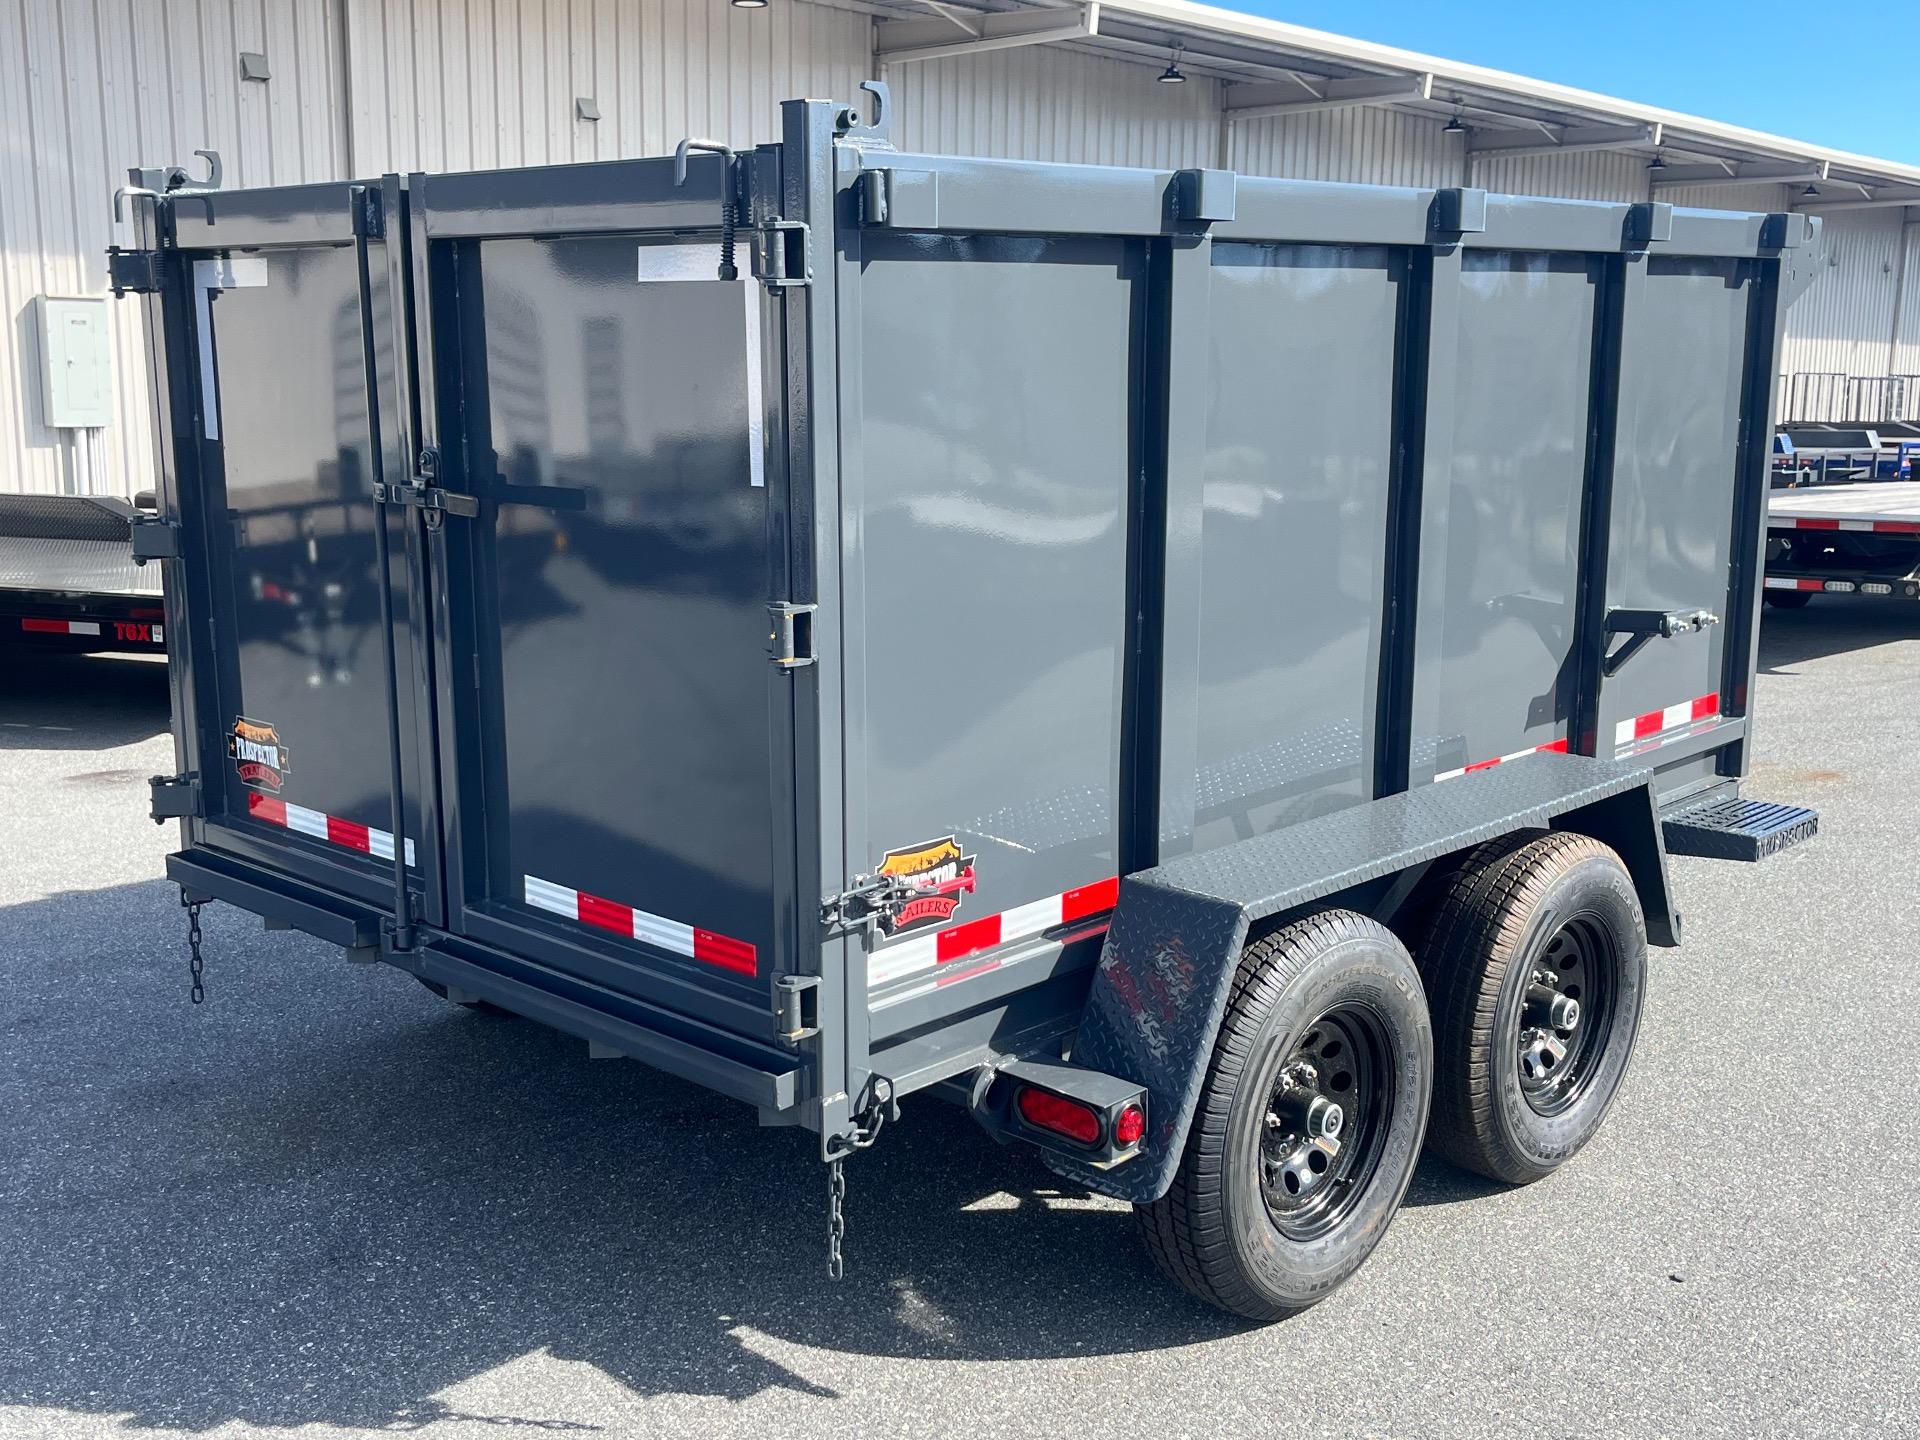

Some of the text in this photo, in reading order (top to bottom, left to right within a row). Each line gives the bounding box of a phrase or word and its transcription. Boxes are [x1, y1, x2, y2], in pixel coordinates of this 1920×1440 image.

[114, 624, 151, 641] T6X
[235, 736, 281, 770] PROSPECTOR
[242, 765, 280, 786] TRAILERS
[896, 900, 951, 925] AILERS
